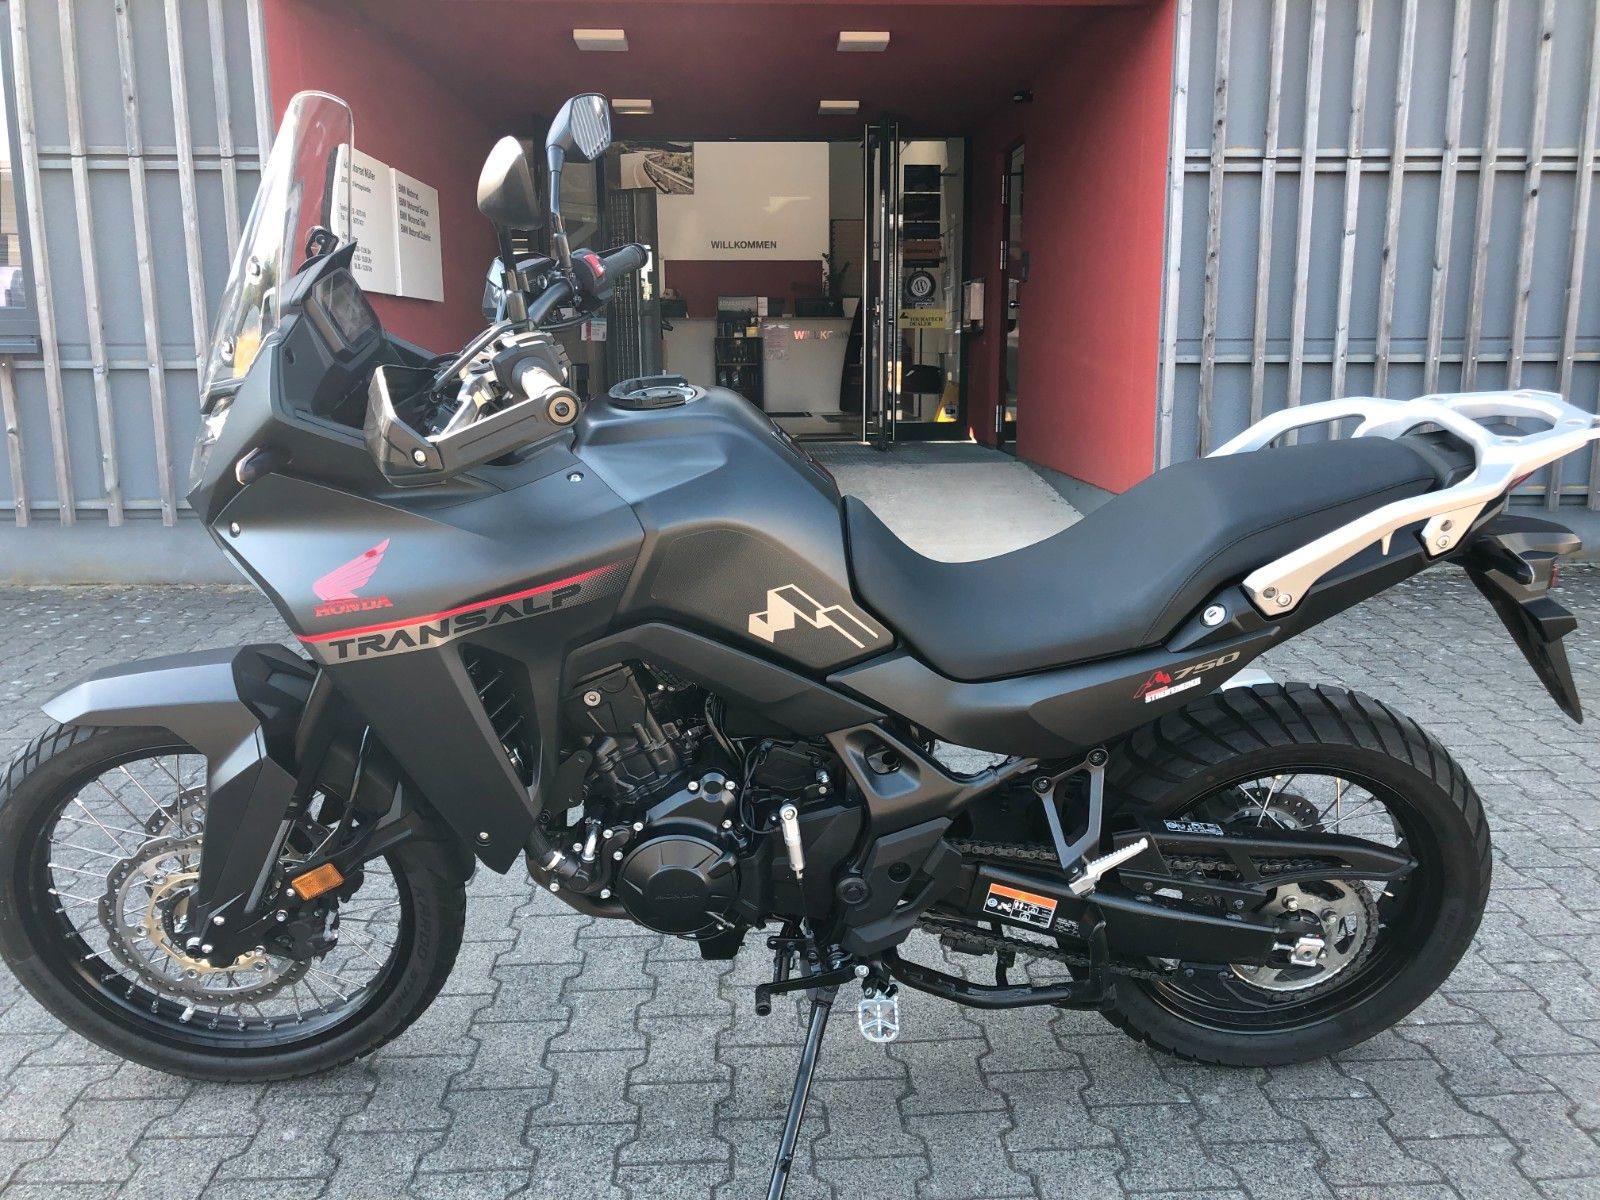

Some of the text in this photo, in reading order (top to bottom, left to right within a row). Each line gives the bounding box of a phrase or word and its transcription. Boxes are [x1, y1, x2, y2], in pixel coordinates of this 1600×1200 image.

[710, 240, 777, 249] WILLKOMMEN
[314, 596, 393, 617] HONDA
[329, 583, 582, 660] TRANSALP
[1174, 651, 1241, 680] 750
